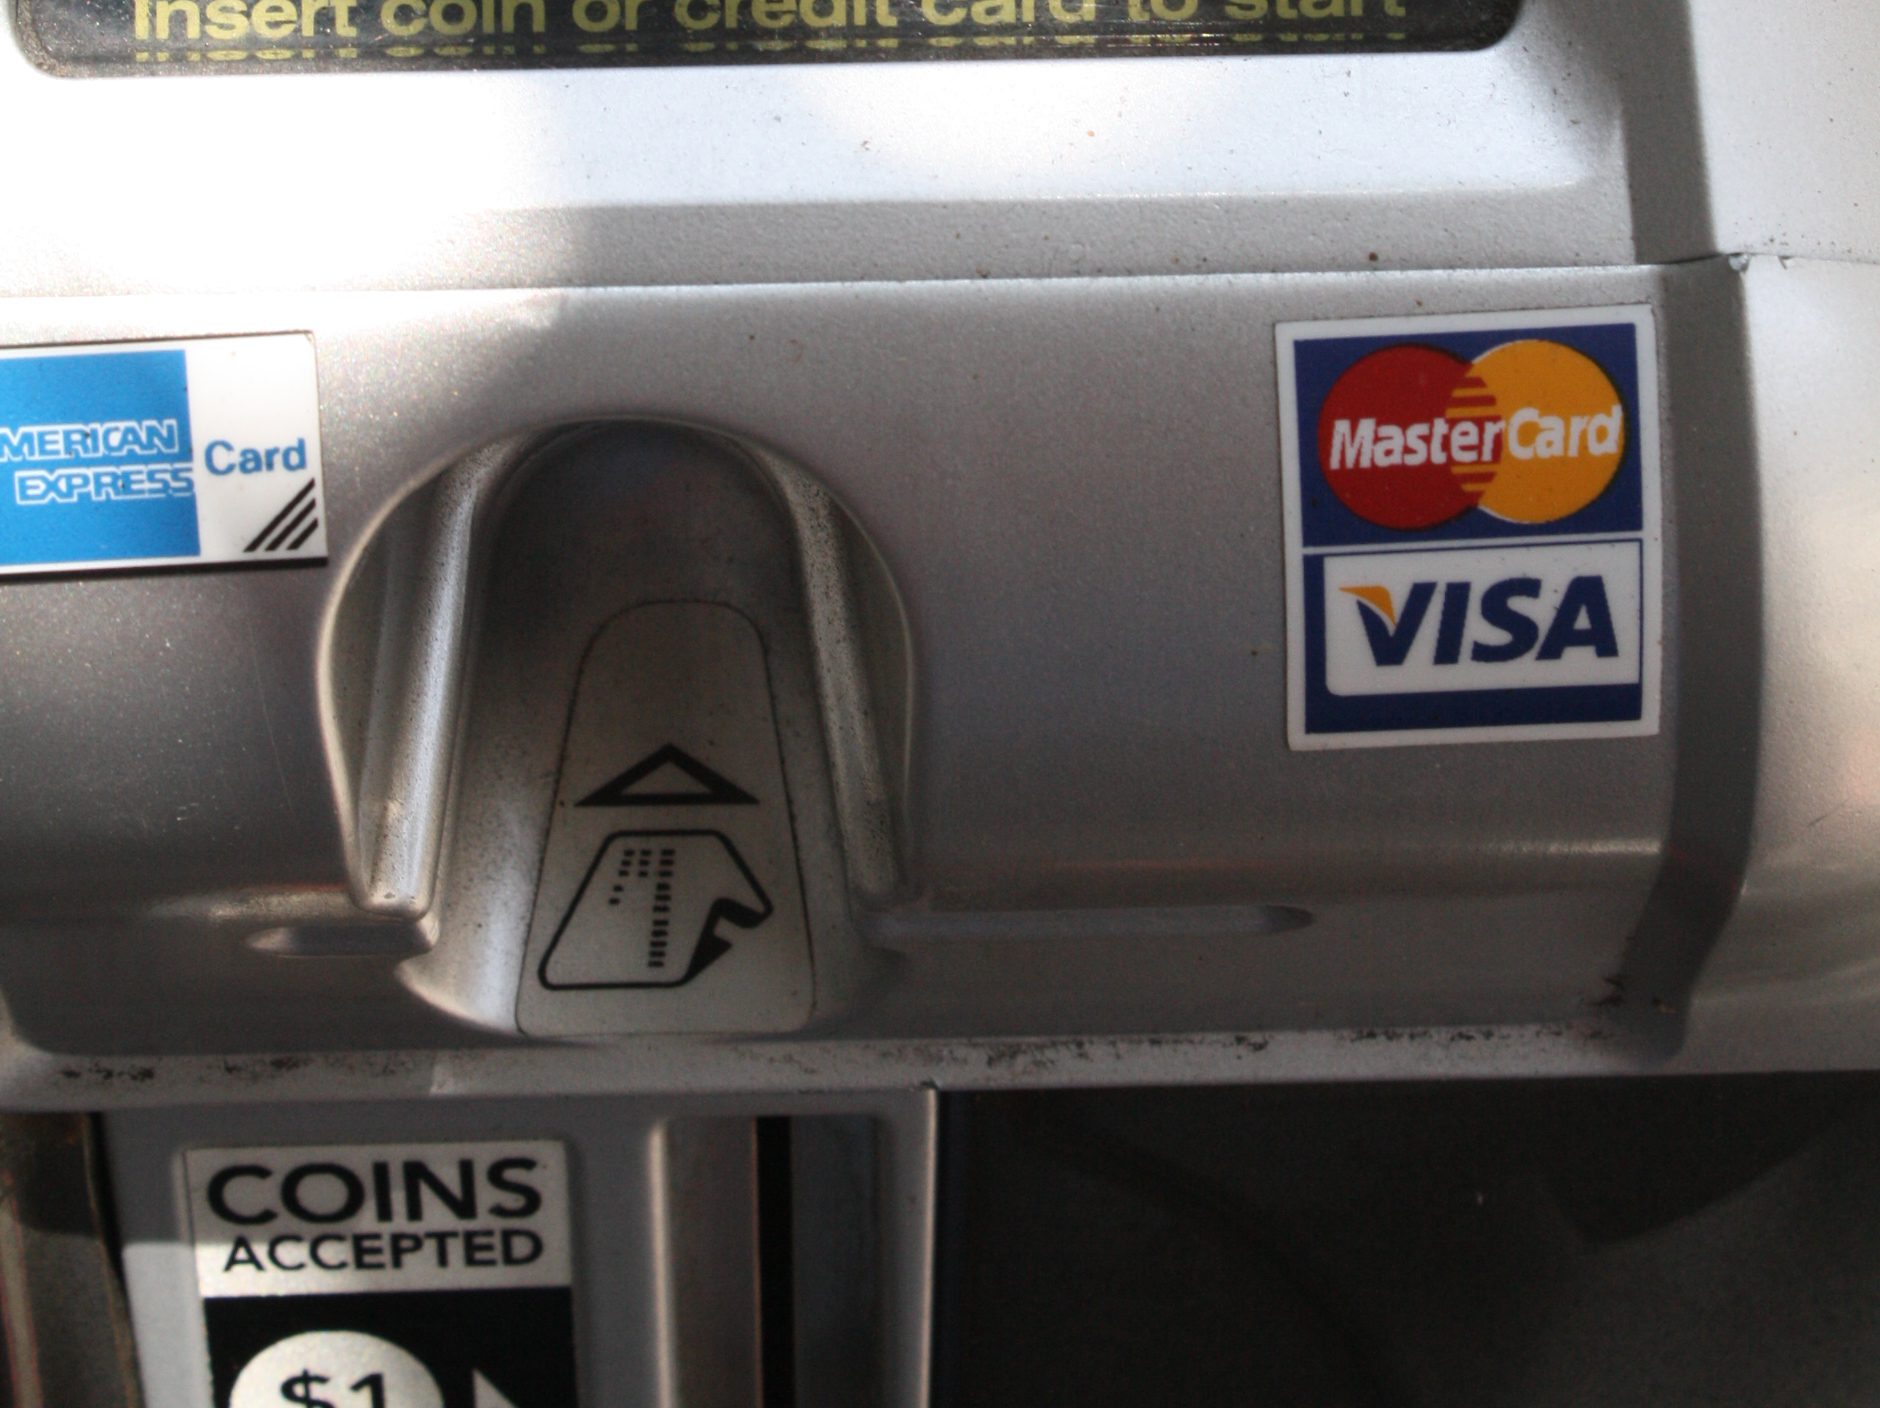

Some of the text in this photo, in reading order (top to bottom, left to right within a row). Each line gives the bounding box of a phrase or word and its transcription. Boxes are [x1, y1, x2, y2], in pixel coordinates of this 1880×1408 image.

[0, 418, 179, 461] MERICAN
[204, 437, 307, 477] Card
[1329, 404, 1623, 470] MasterCard
[15, 463, 194, 505] EXPRESS
[1338, 575, 1620, 667] VISA
[207, 1157, 542, 1225] COINS
[223, 1228, 543, 1272] ACCEPTED
